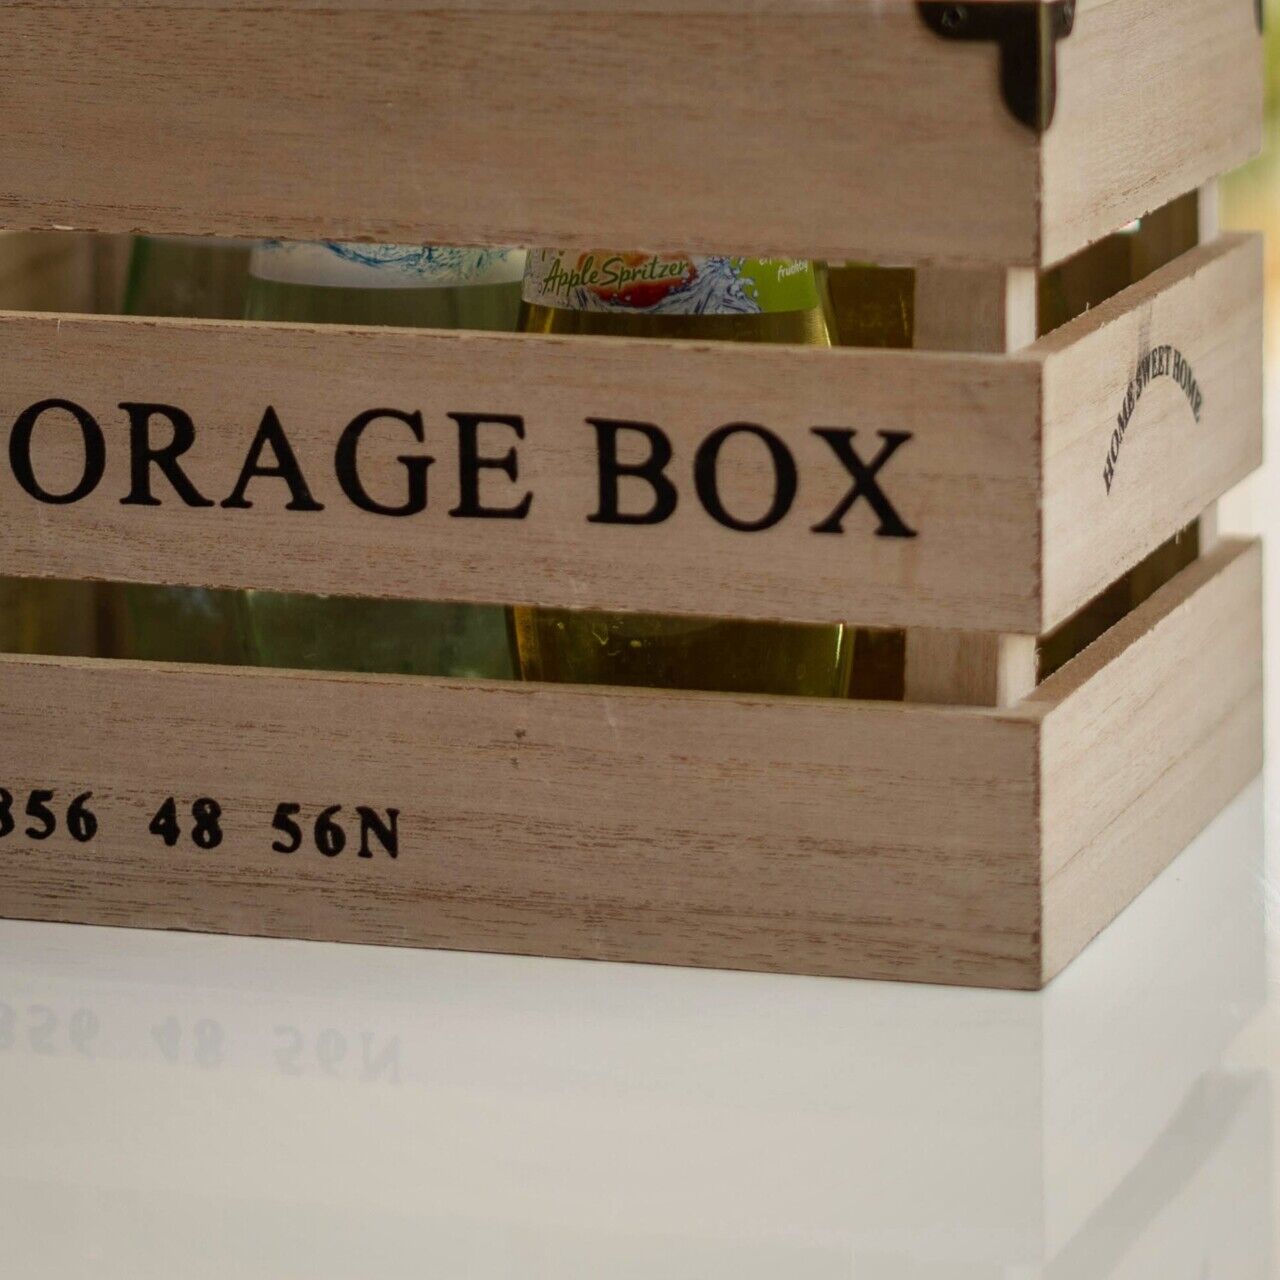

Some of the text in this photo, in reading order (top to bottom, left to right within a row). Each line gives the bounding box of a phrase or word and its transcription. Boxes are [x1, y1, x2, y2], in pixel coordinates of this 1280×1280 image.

[584, 416, 920, 541] BOX
[1102, 344, 1203, 496] HOME SWEET HOME
[146, 795, 227, 851] 48
[267, 801, 401, 860] 56N
